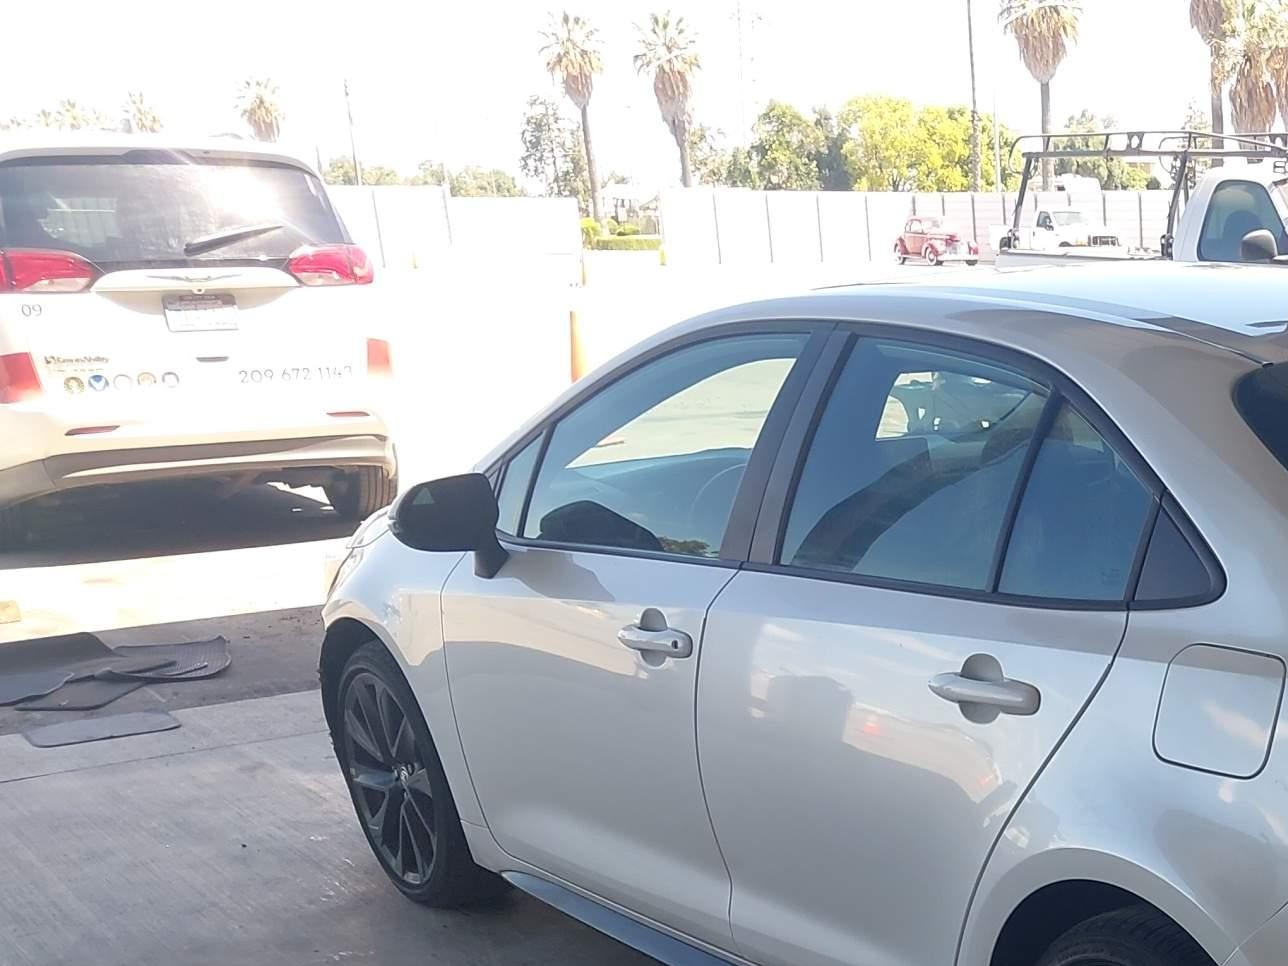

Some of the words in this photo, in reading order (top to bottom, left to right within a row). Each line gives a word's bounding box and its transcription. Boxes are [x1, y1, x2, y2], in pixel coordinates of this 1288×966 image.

[21, 303, 43, 318] 09
[239, 368, 274, 384] 209
[281, 367, 312, 382] 672
